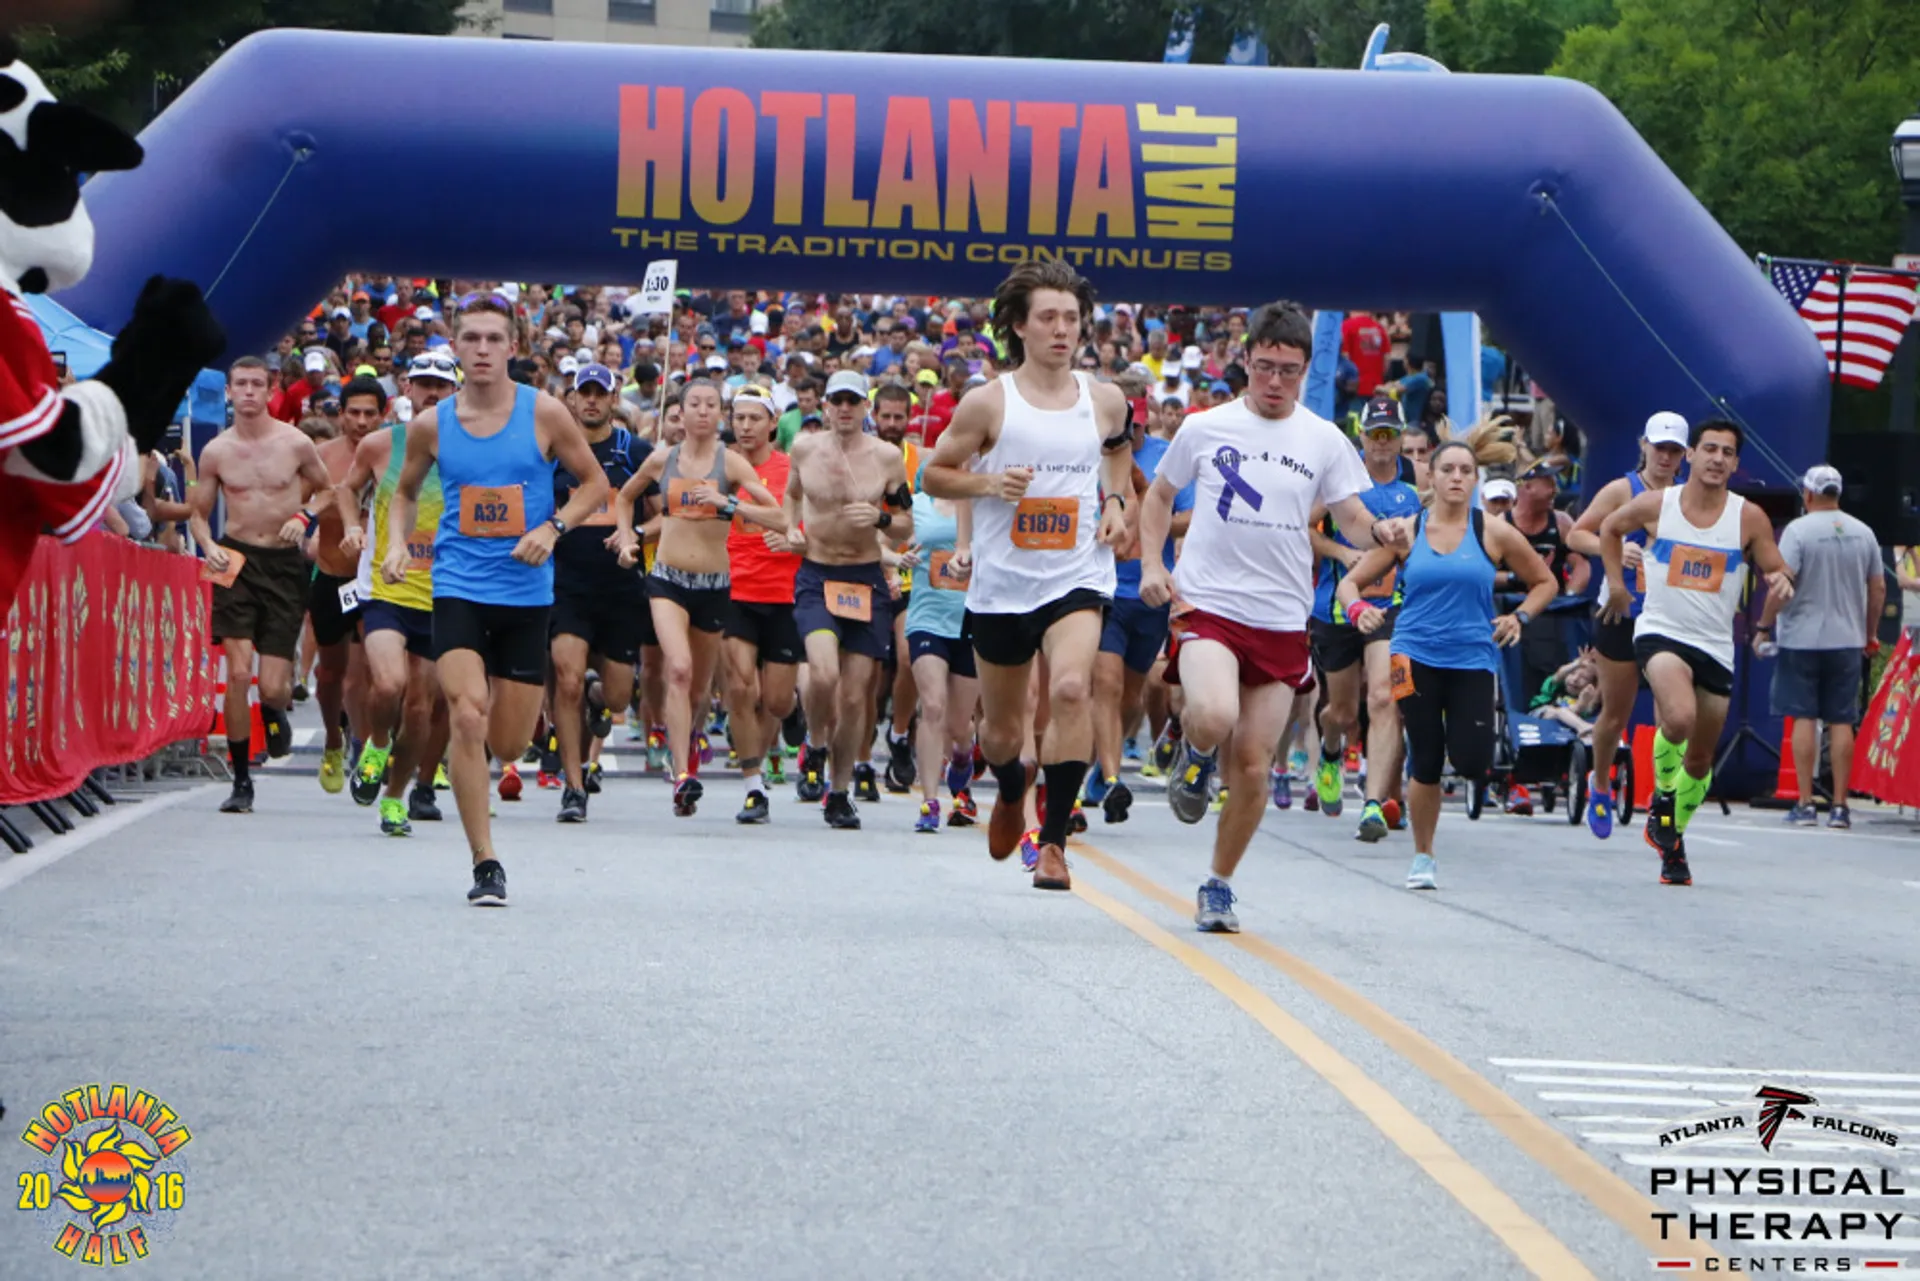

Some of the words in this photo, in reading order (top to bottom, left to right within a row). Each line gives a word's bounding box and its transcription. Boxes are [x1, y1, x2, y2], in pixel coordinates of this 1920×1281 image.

[616, 83, 1136, 238] HOTLANTA
[1136, 103, 1238, 241] HALF
[611, 228, 698, 251] THE
[708, 232, 954, 261] TRADITION
[965, 242, 1232, 271] CONTINUES
[1280, 454, 1314, 480] Myles
[474, 503, 508, 522] A32
[1017, 512, 1071, 535] E1879
[1681, 559, 1712, 579] A80
